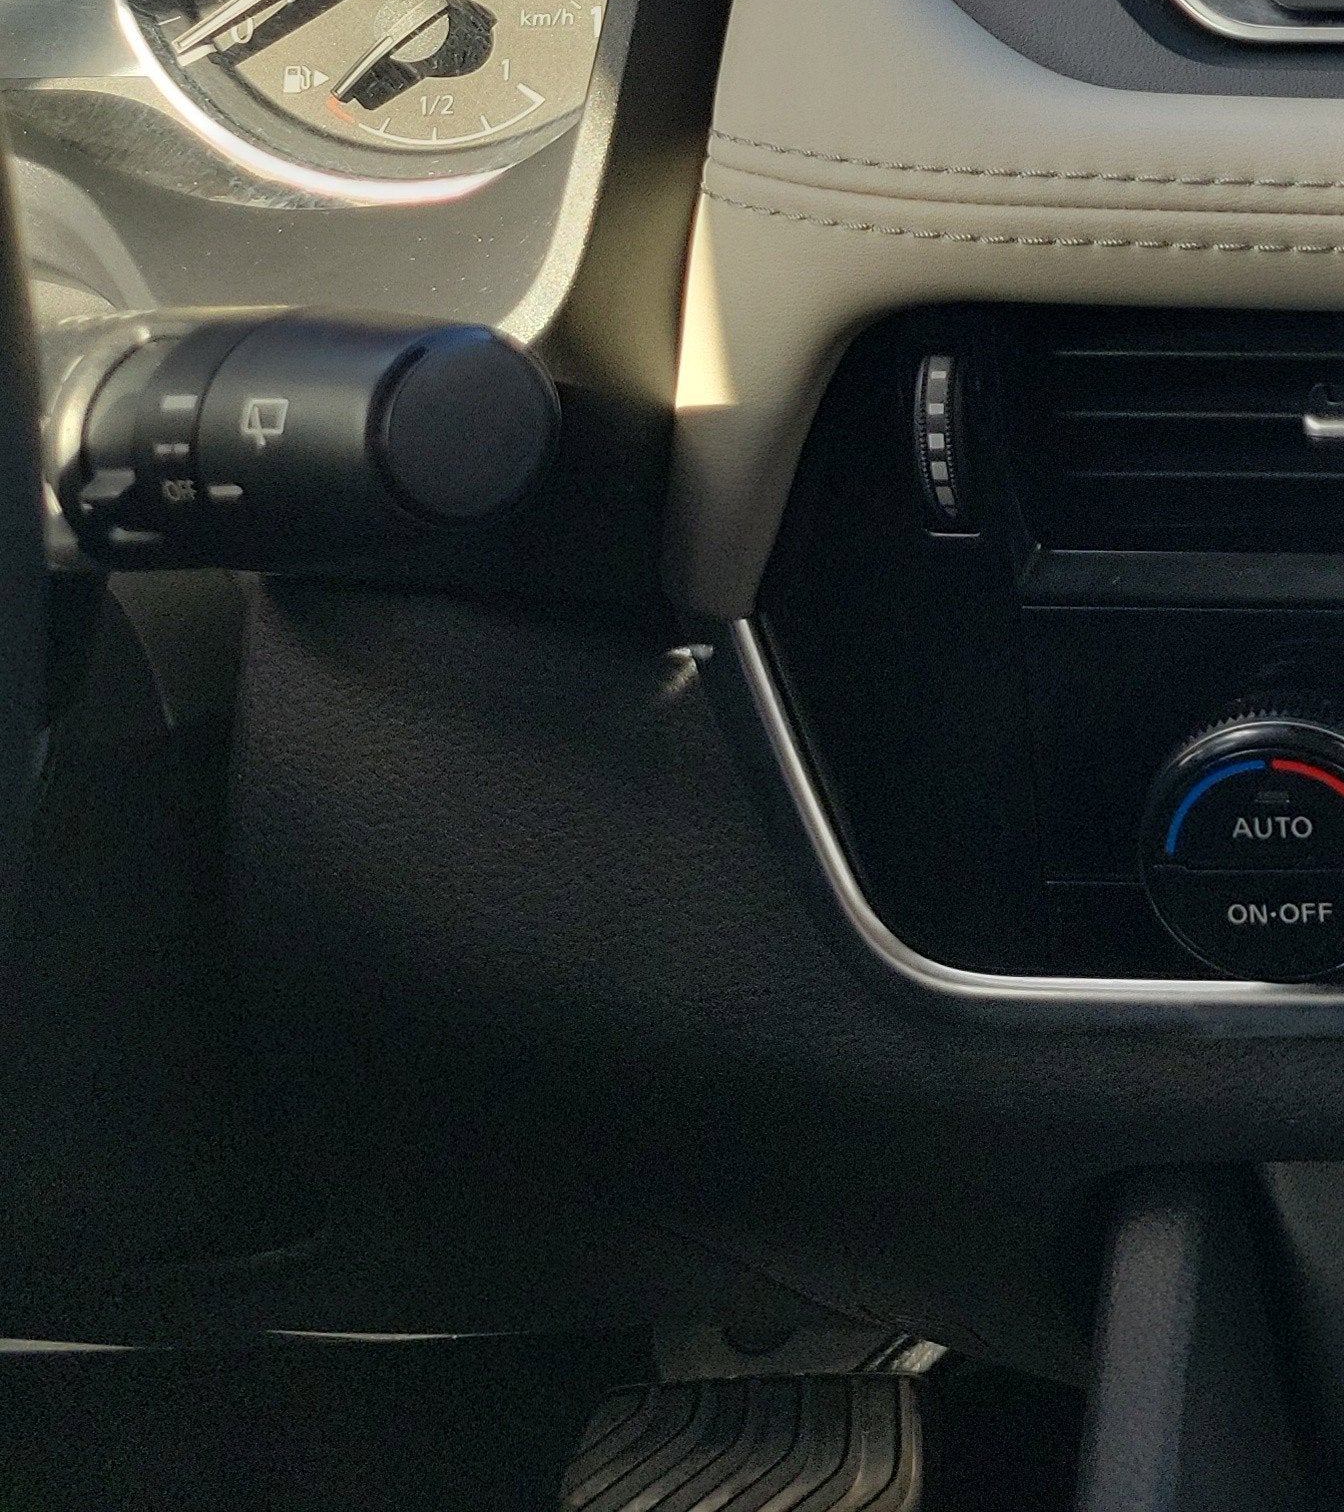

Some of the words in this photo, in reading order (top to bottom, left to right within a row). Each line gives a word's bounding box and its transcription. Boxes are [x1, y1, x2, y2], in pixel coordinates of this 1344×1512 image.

[520, 9, 574, 27] km/h
[502, 61, 510, 81] 1
[420, 95, 454, 116] 1/2
[1233, 816, 1312, 838] AUTO
